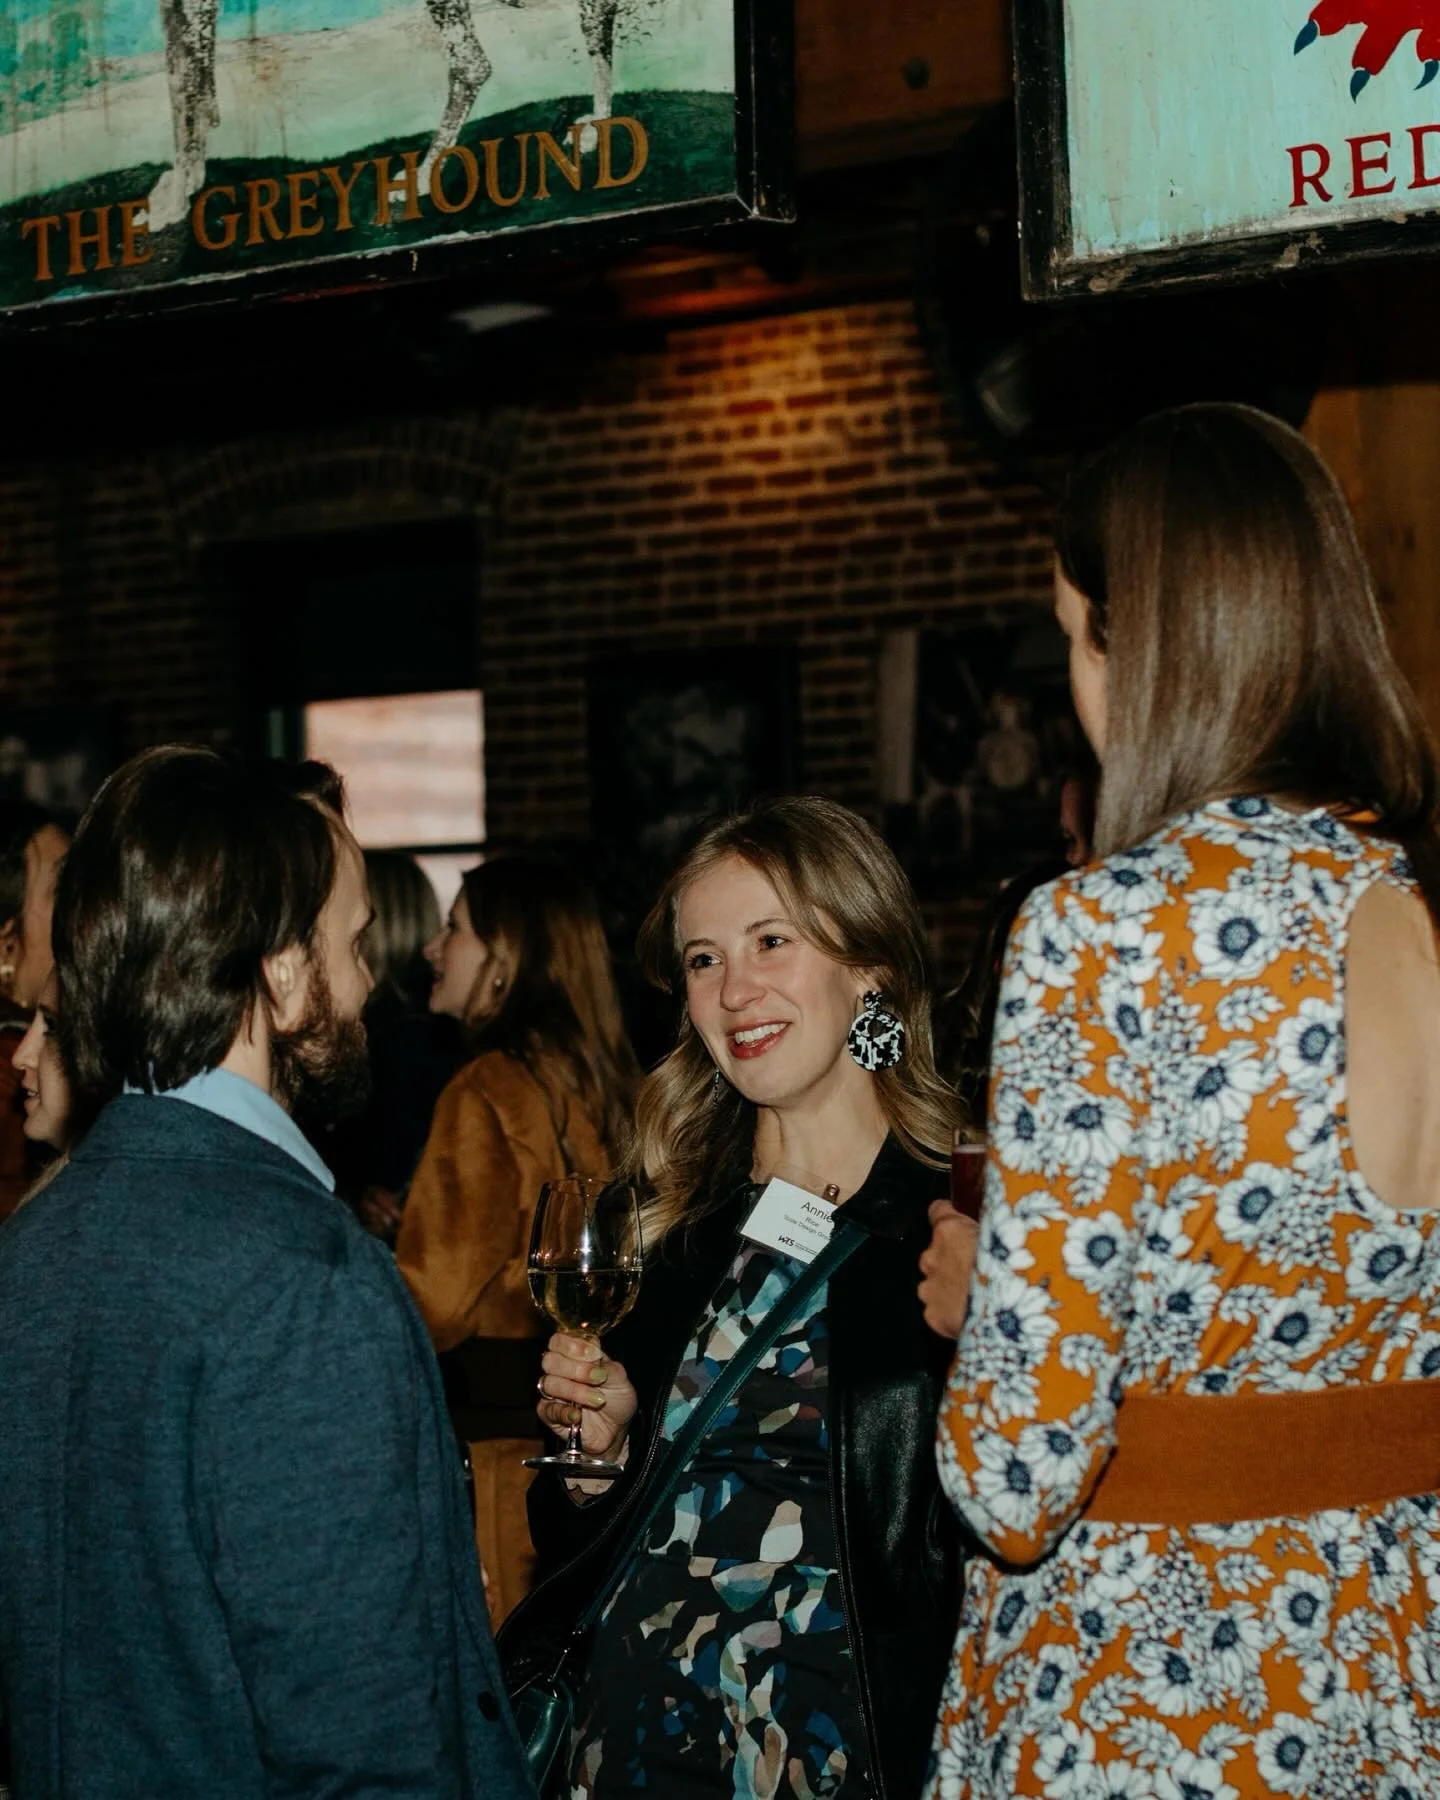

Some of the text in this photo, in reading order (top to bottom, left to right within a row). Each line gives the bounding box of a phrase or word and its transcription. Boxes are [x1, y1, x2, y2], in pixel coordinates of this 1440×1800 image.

[20, 115, 650, 281] THE GREYHOUND
[801, 1201, 832, 1223] Annie
